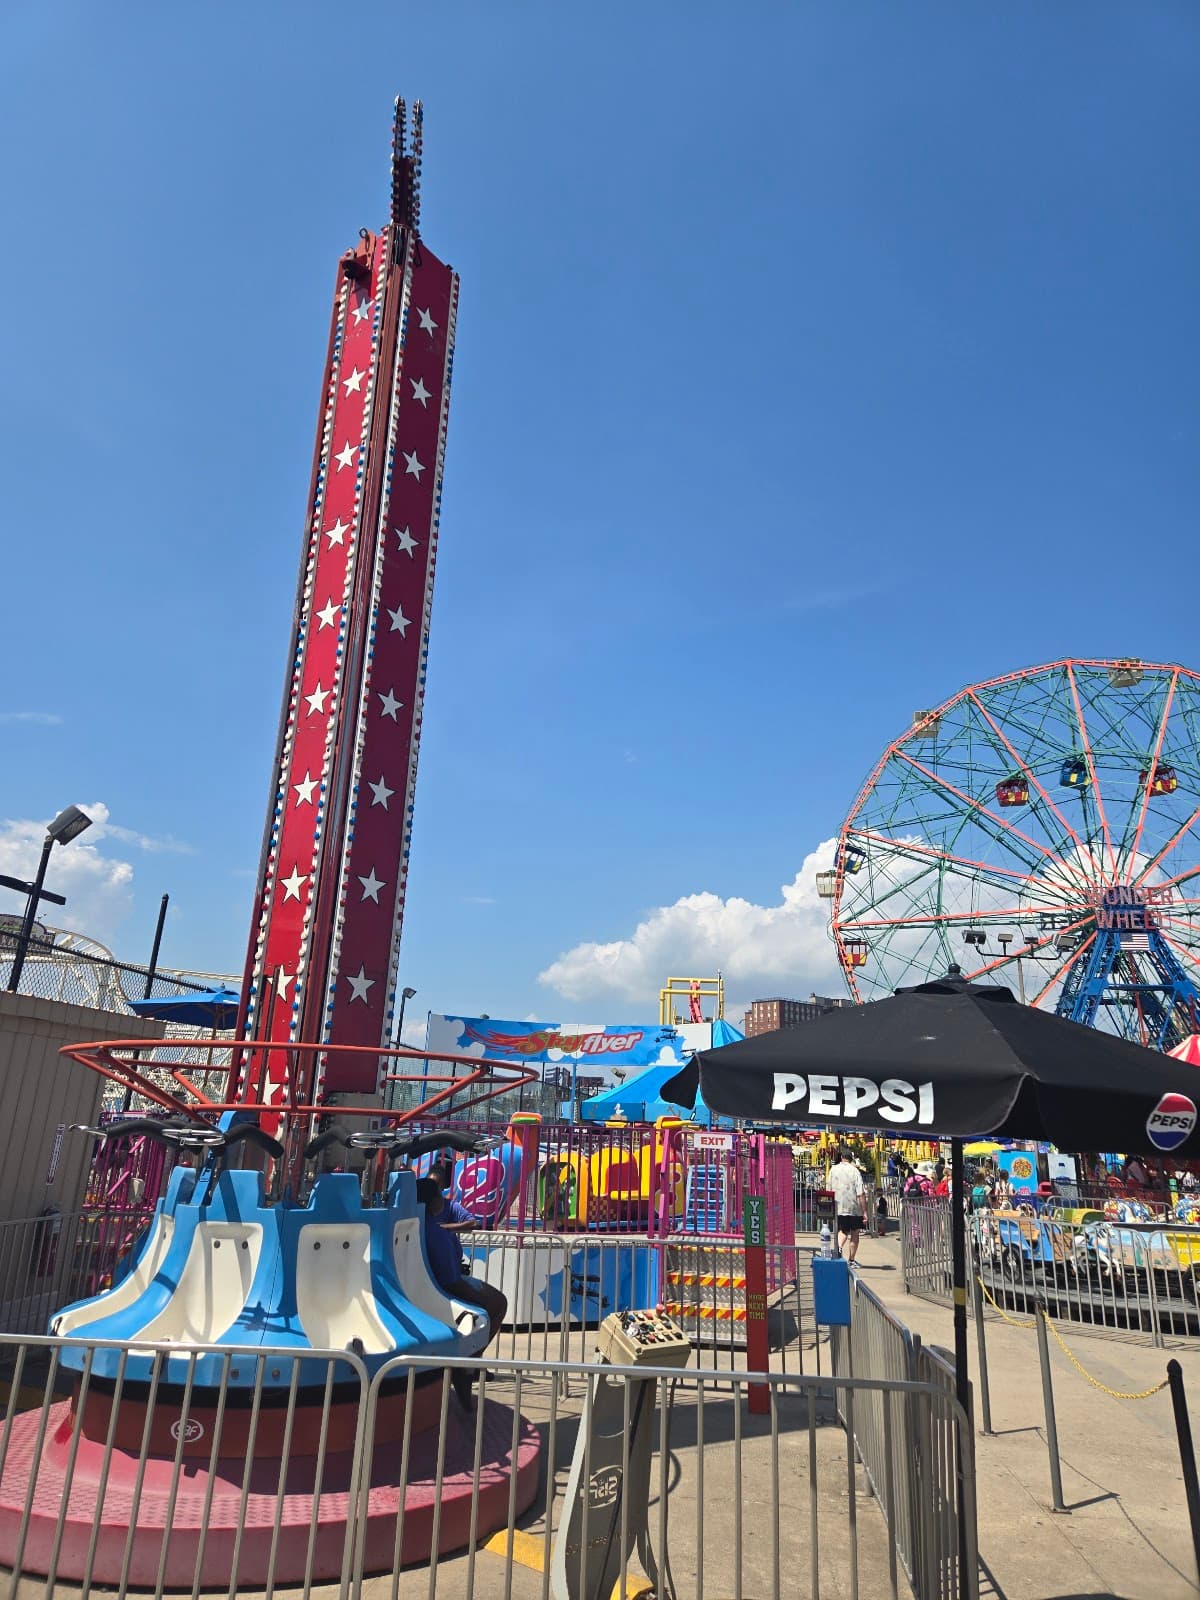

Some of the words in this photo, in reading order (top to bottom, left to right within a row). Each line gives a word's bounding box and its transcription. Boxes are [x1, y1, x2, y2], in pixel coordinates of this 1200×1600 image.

[1085, 887, 1173, 905] WONDER
[1095, 909, 1171, 929] WHEEL
[771, 1072, 935, 1125] PEPSI
[1150, 1113, 1194, 1130] PEPSI
[700, 1136, 726, 1146] EXIT
[458, 1155, 505, 1217] 2
[749, 1200, 761, 1244] YES
[749, 1311, 766, 1320] TIME
